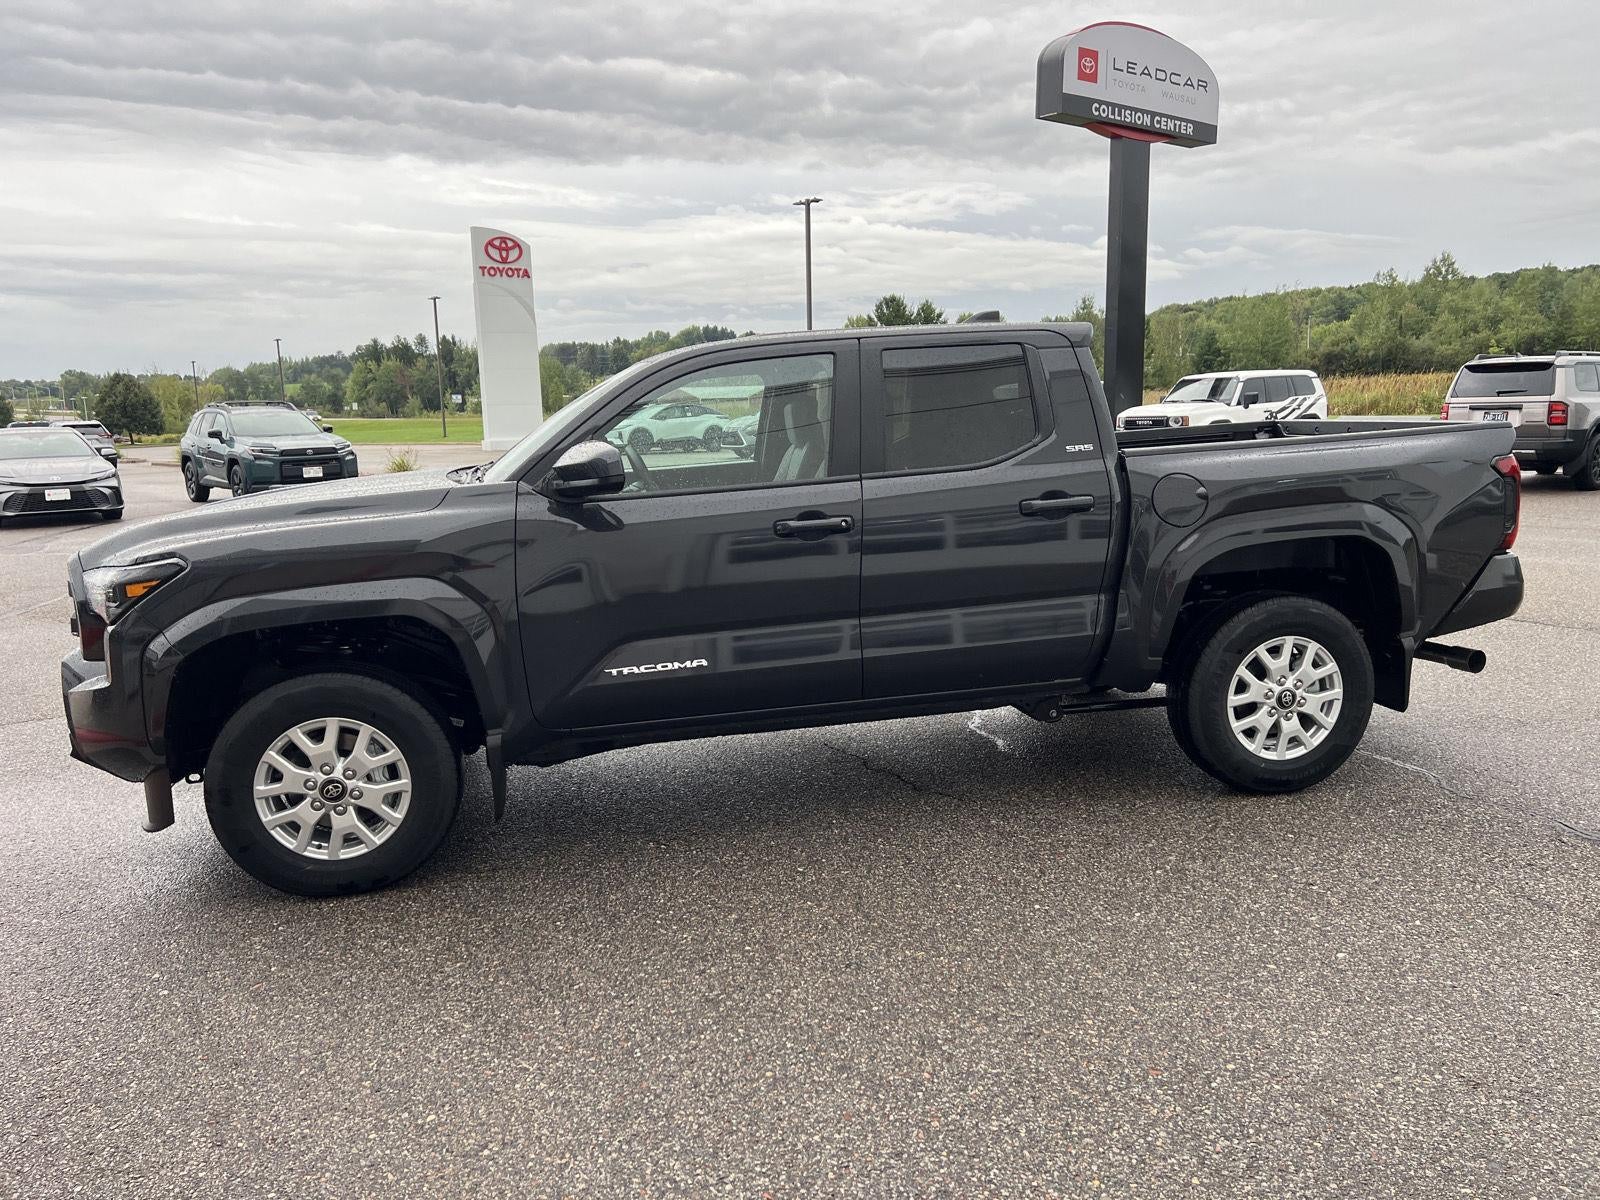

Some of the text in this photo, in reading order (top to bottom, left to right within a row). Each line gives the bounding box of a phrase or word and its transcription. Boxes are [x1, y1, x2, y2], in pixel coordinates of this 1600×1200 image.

[1112, 57, 1208, 93] LEADCAR
[1112, 78, 1196, 105] TOYOTA WAUSAU
[1091, 102, 1194, 135] COLLISION CENTER
[478, 265, 530, 279] TOYOTA
[1065, 443, 1094, 453] SR5
[603, 658, 708, 676] TACOMA
